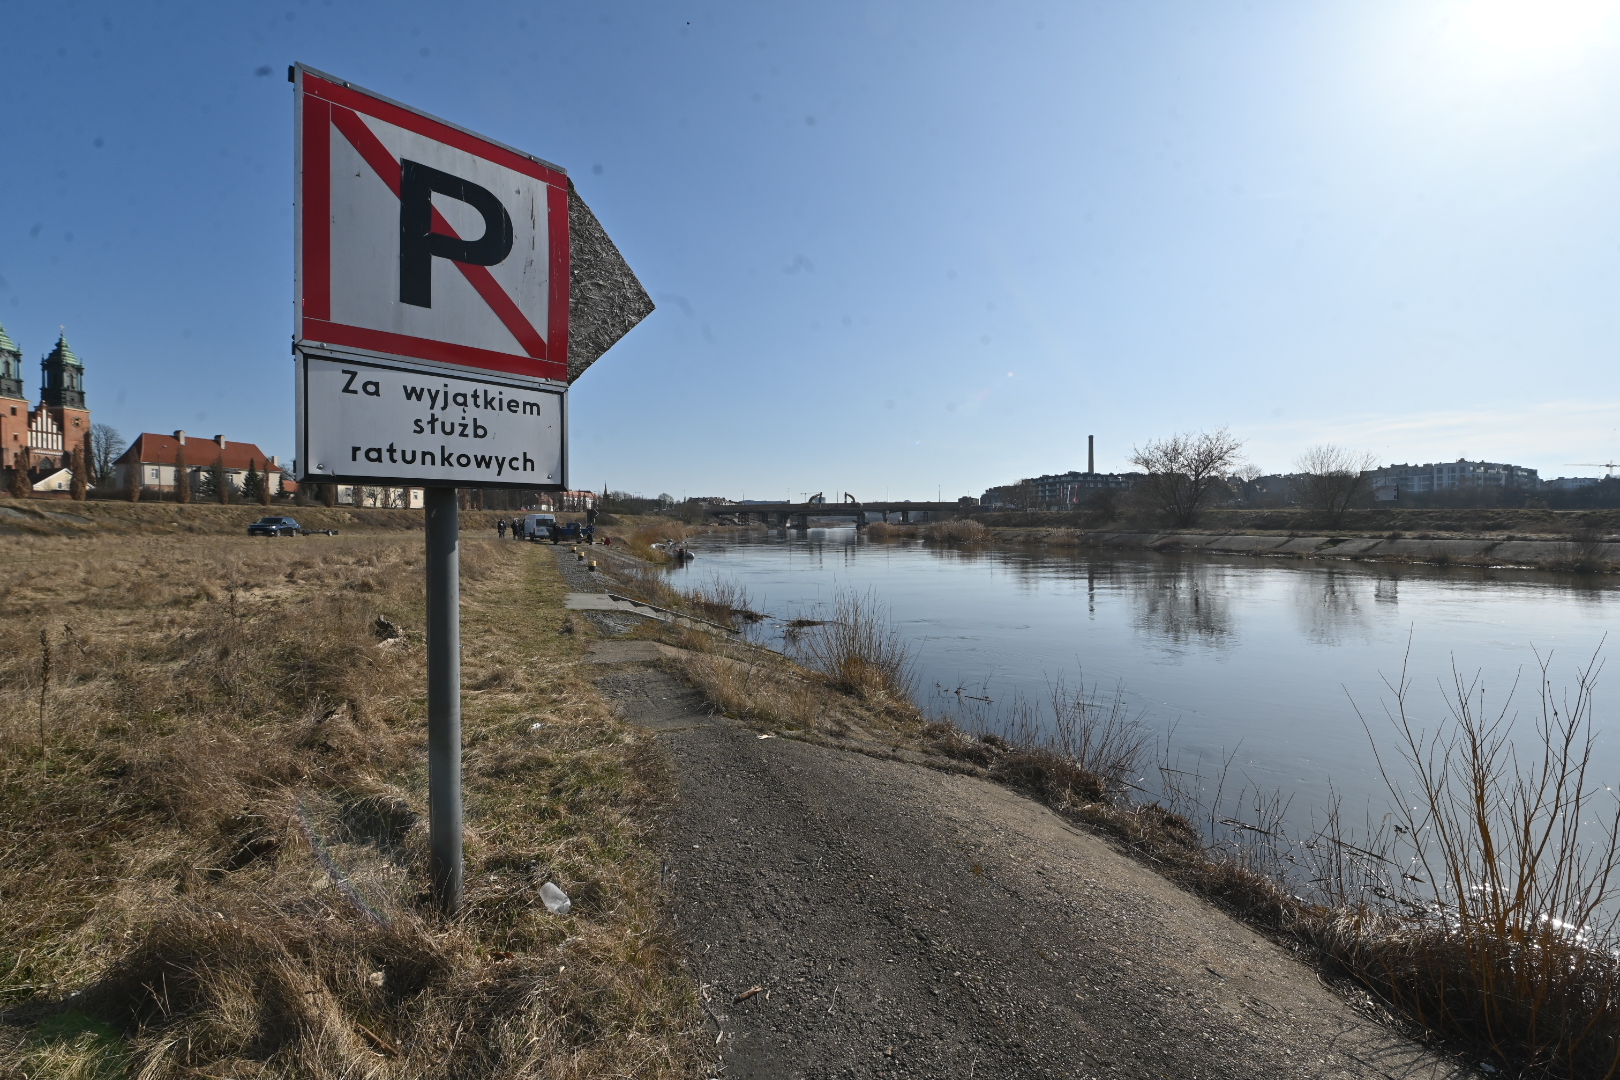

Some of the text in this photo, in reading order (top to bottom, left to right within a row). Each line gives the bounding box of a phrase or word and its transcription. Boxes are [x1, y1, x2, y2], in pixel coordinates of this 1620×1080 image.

[400, 157, 514, 308] P
[341, 369, 541, 417] Za wyjątkiem
[413, 413, 488, 439] służb
[351, 442, 535, 476] ratunkowych
